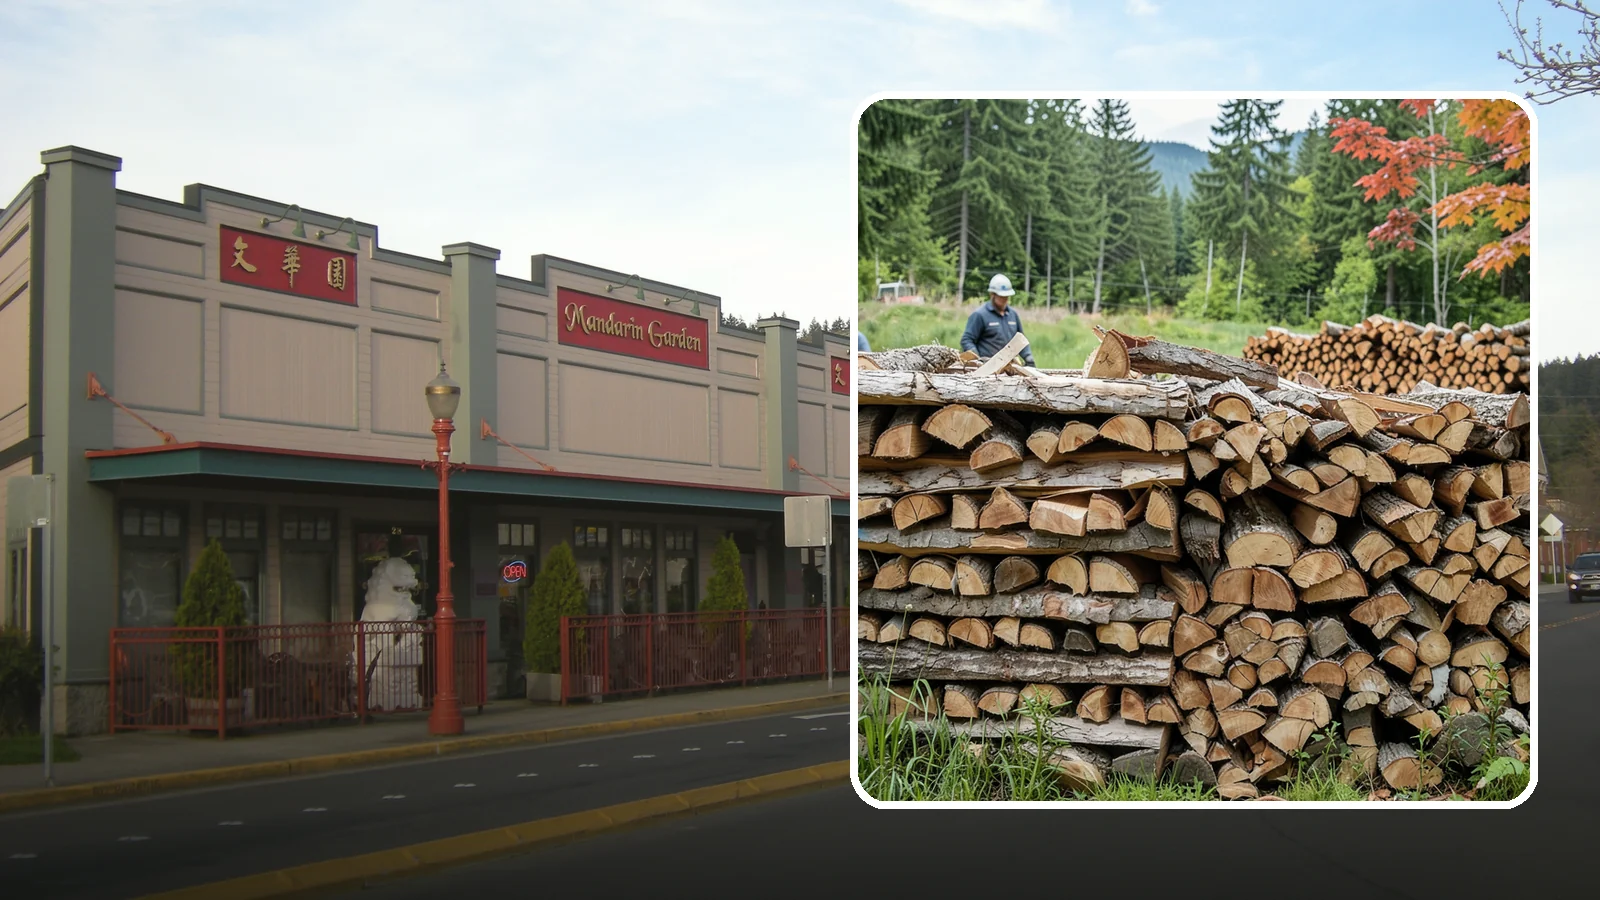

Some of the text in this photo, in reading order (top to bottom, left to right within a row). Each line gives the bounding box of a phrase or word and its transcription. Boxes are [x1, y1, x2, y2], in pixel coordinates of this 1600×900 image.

[231, 236, 346, 291] 文華園
[564, 302, 702, 353] Mandarin Garden
[503, 565, 527, 578] OPEN
